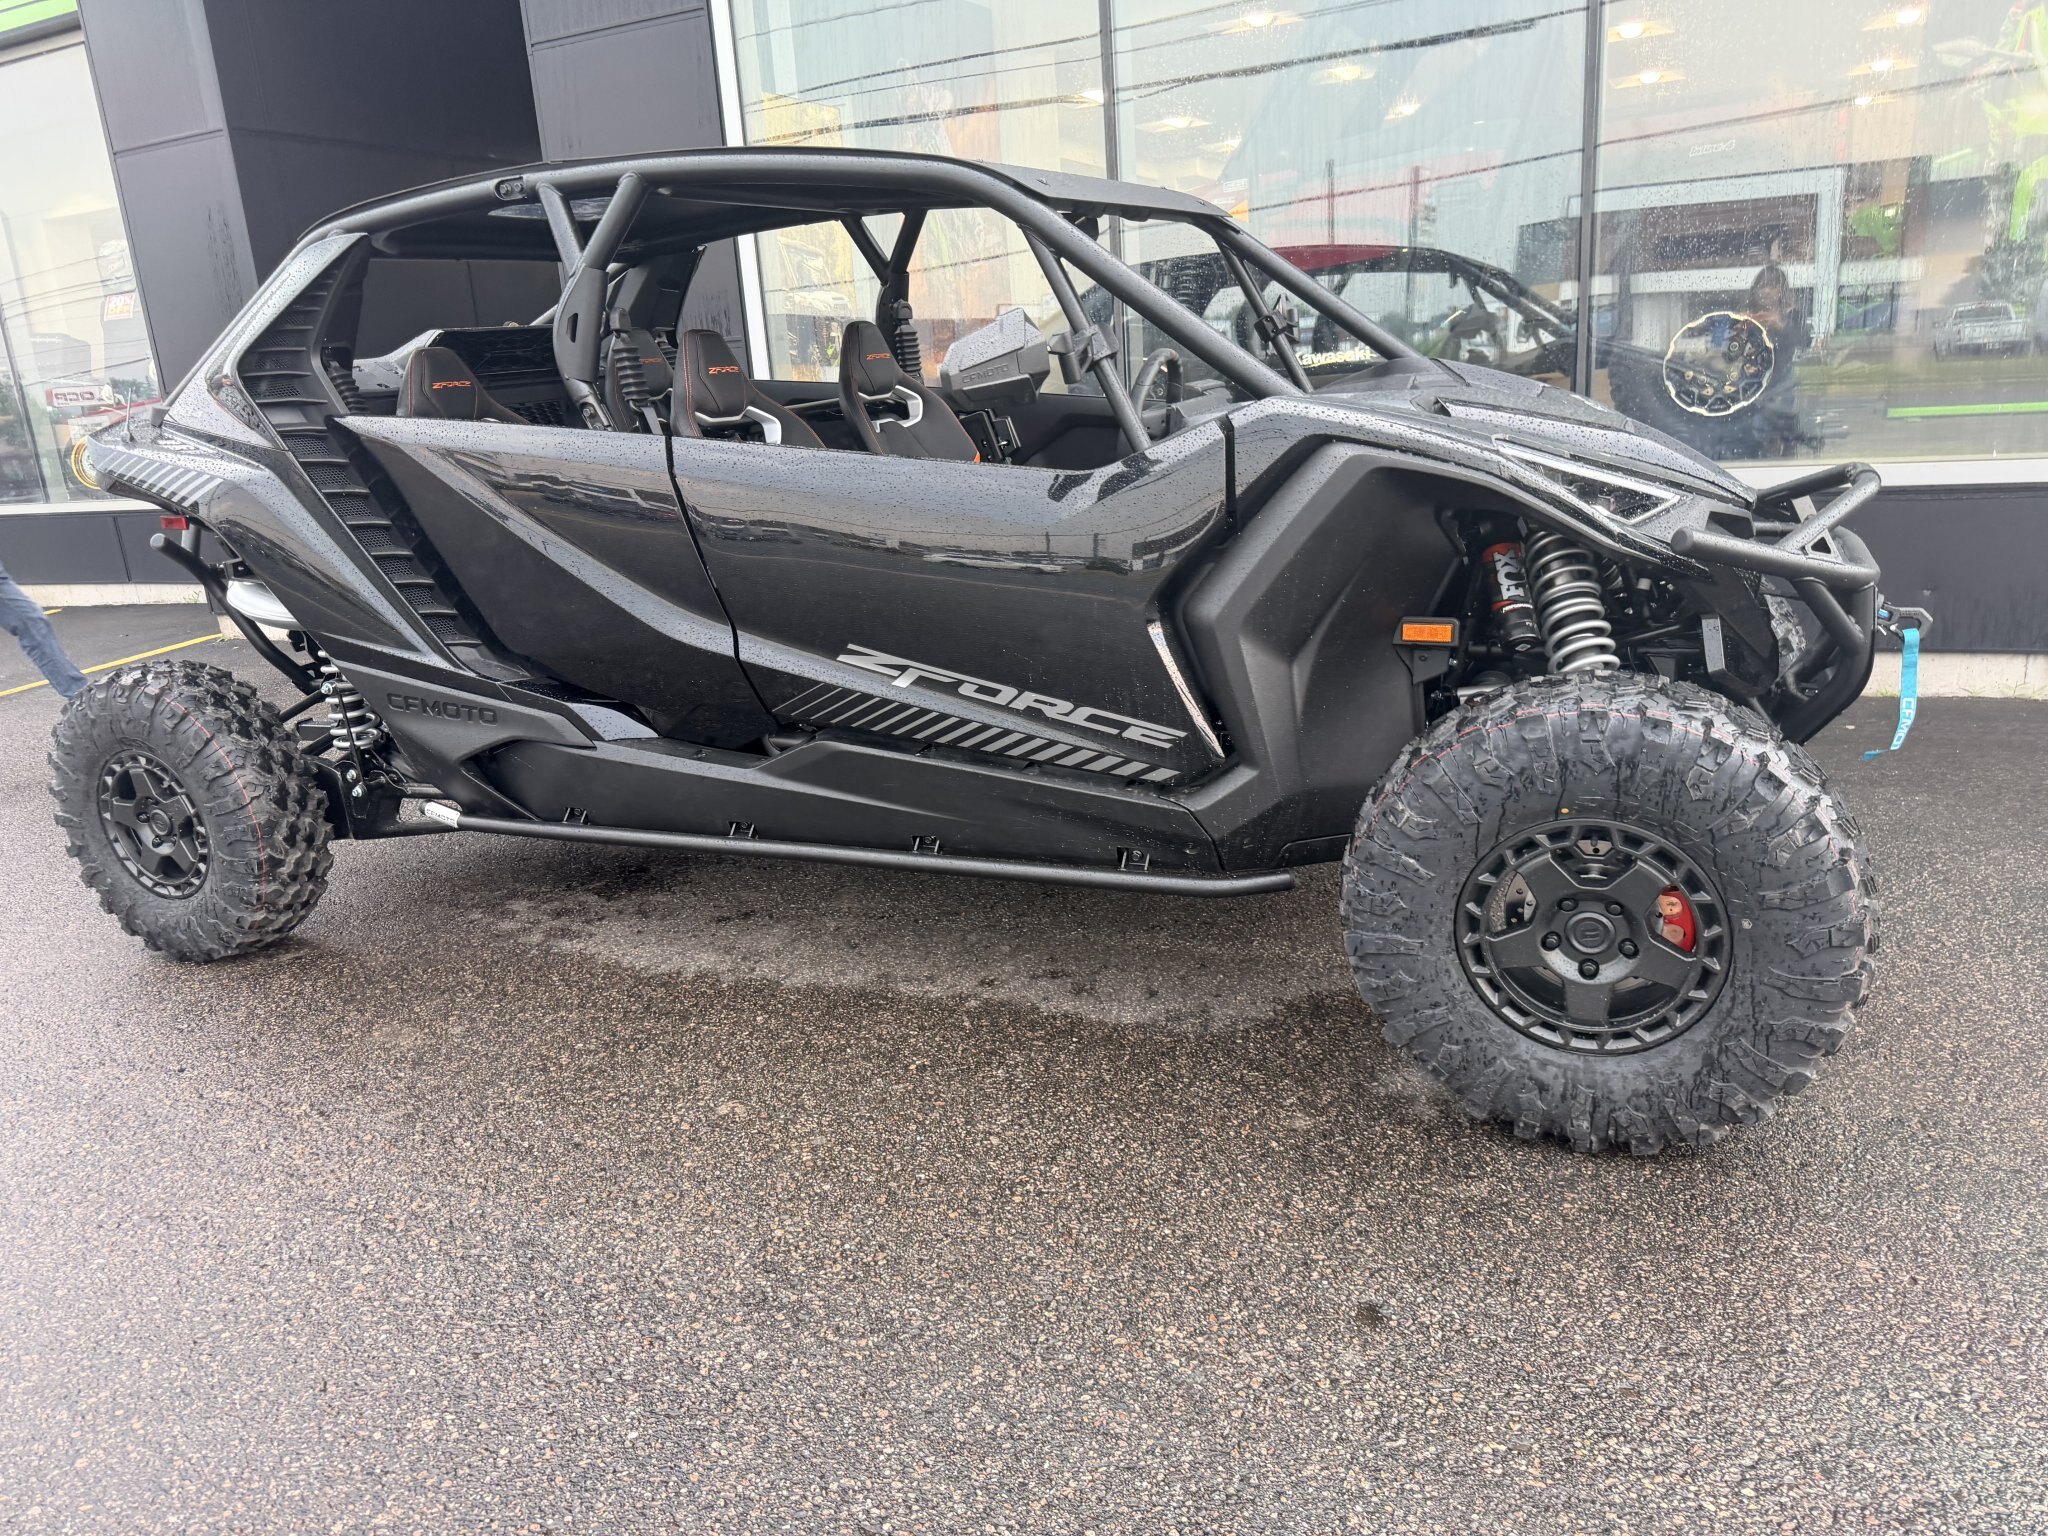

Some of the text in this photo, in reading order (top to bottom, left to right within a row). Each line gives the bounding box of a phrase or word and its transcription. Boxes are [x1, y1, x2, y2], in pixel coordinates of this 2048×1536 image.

[961, 363, 1009, 385] CFMOTO
[1493, 549, 1526, 600] FOX
[387, 692, 498, 727] CFMOTO
[837, 643, 1189, 749] ZFORCE
[1891, 697, 1915, 750] CFMO
